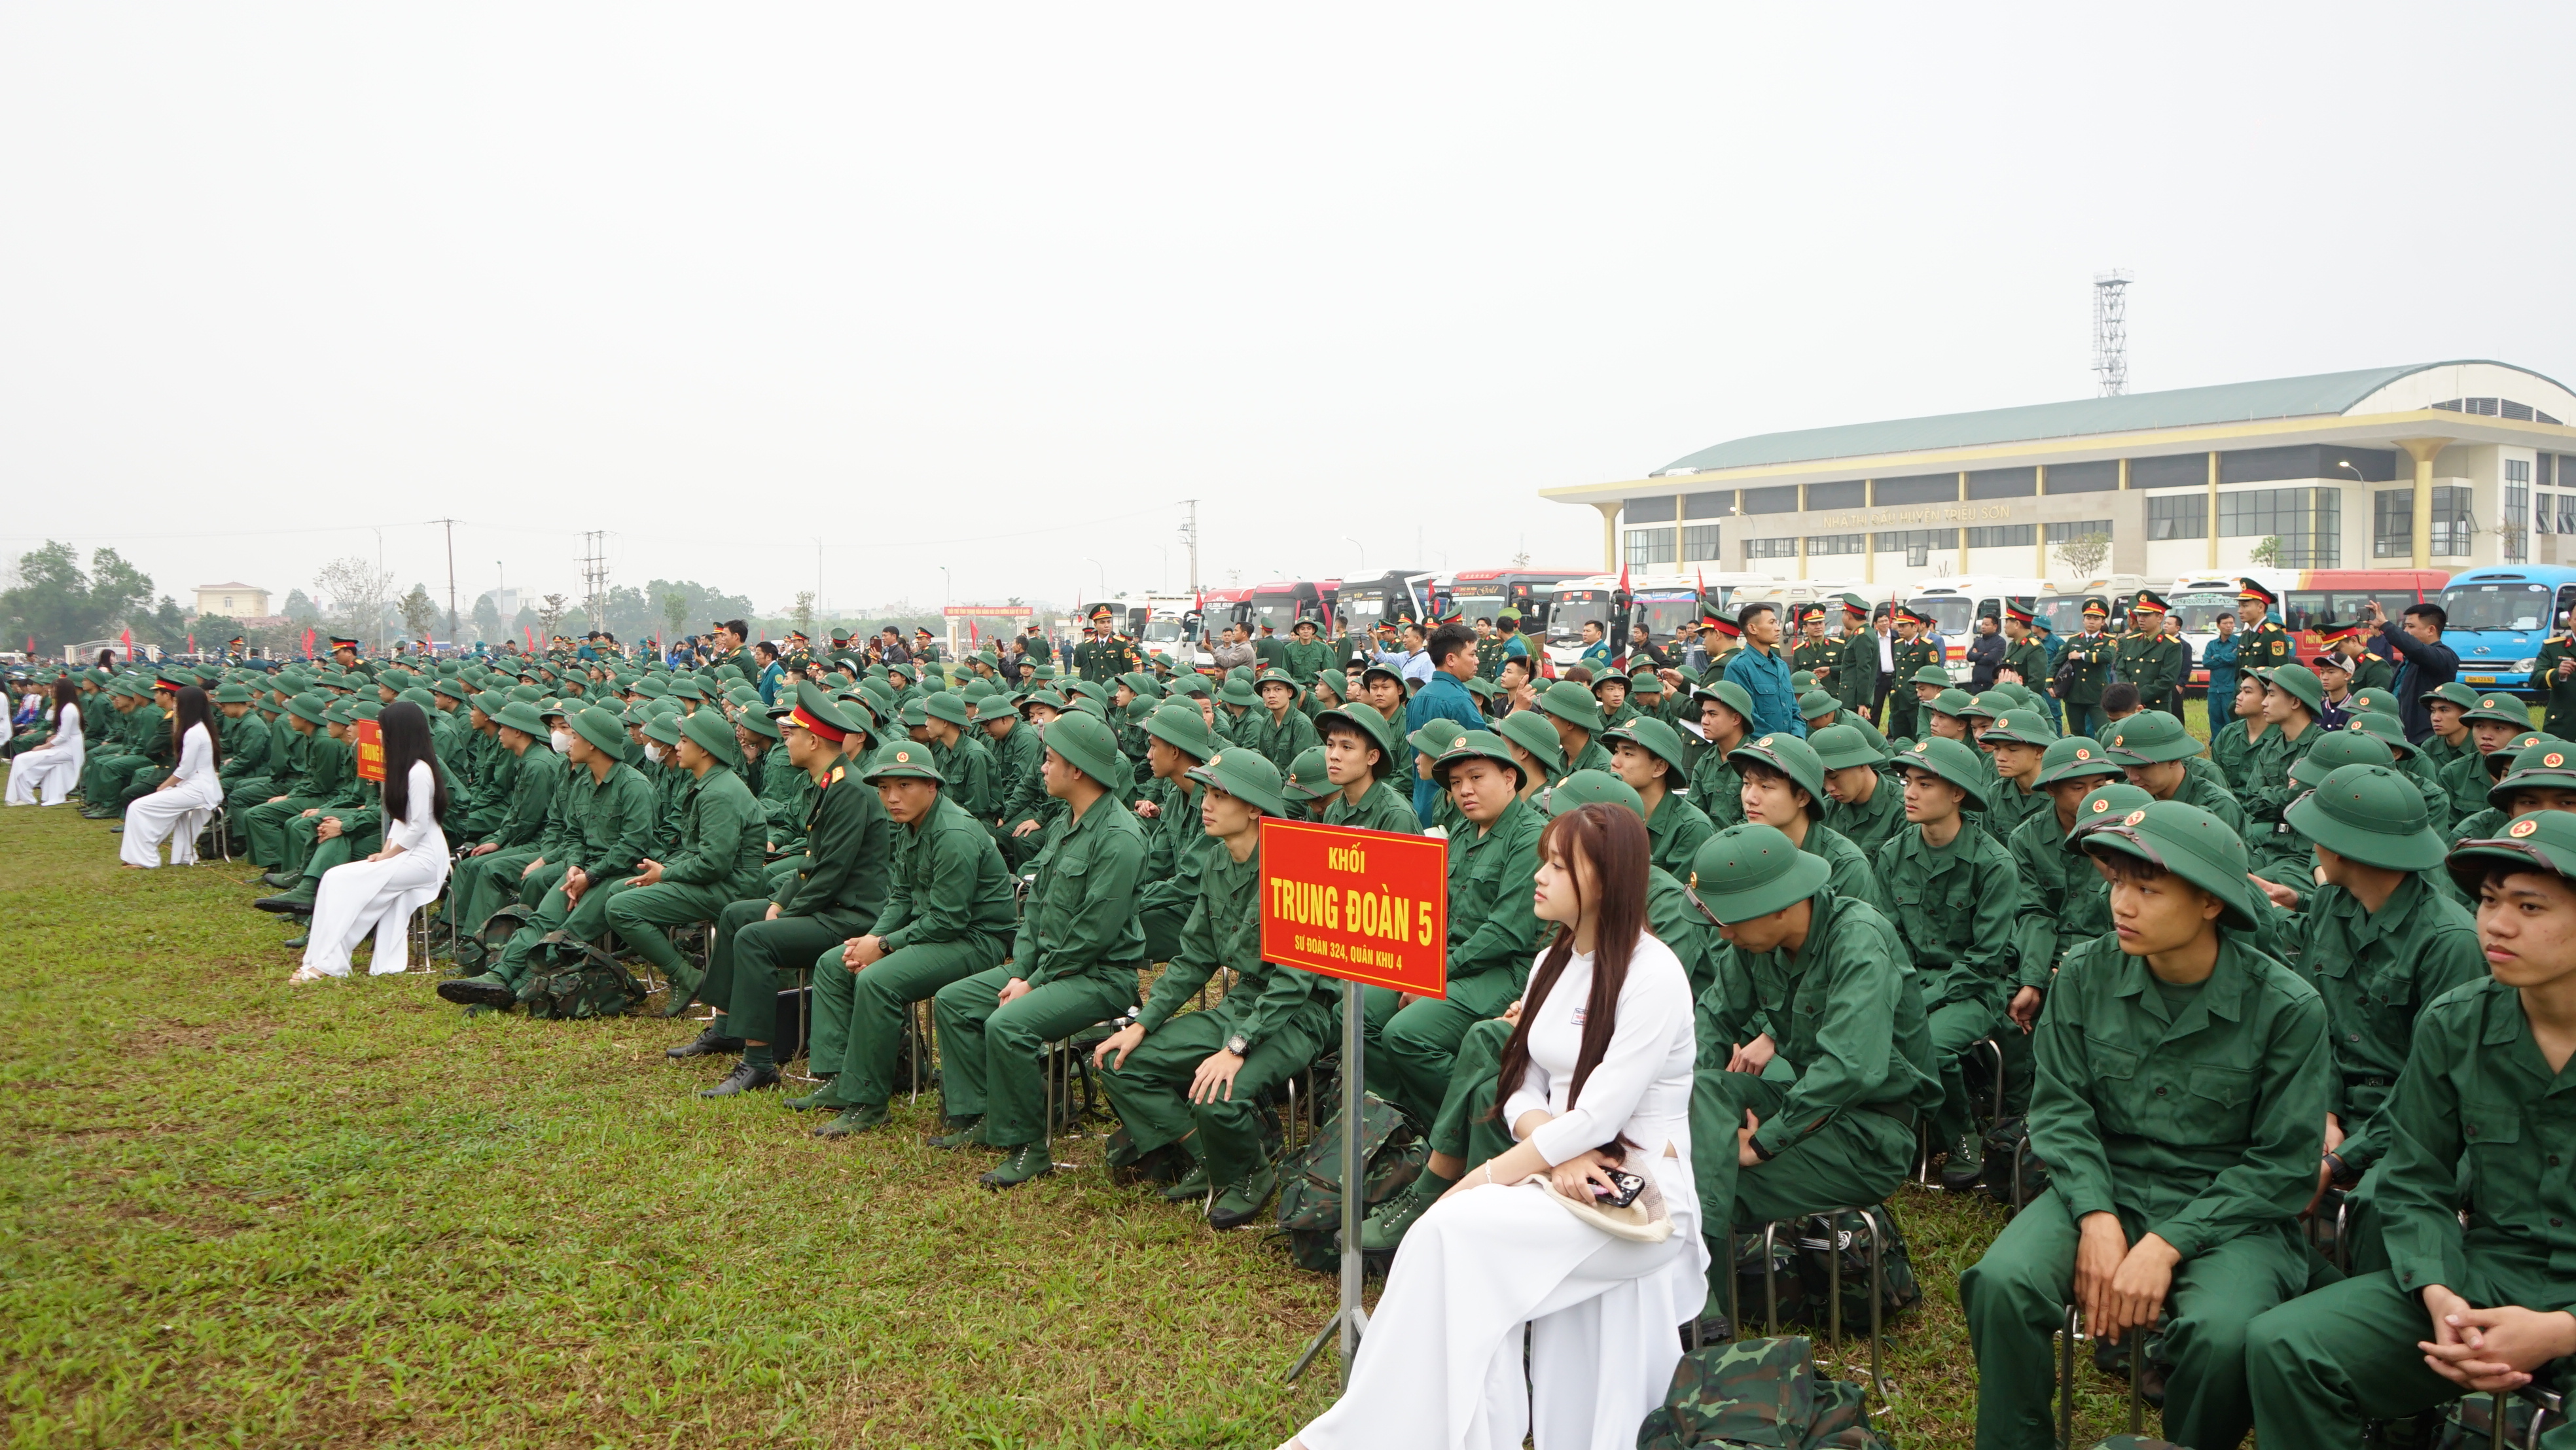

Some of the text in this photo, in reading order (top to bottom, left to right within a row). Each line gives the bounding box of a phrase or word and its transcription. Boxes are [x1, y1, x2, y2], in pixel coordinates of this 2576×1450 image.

[1823, 512, 1849, 528] NHÀ
[1870, 509, 1896, 526] ĐẤU
[1900, 507, 1941, 525] HUYỆN
[1944, 505, 1977, 523] TRIỆU
[1980, 504, 2010, 520] SƠN
[1329, 841, 1365, 874] KHỐI
[1270, 877, 1433, 947] TRUNG ĐOÀN 5
[1295, 934, 1403, 971] SƯ ĐOÀN 324, QUÂN KHU 4
